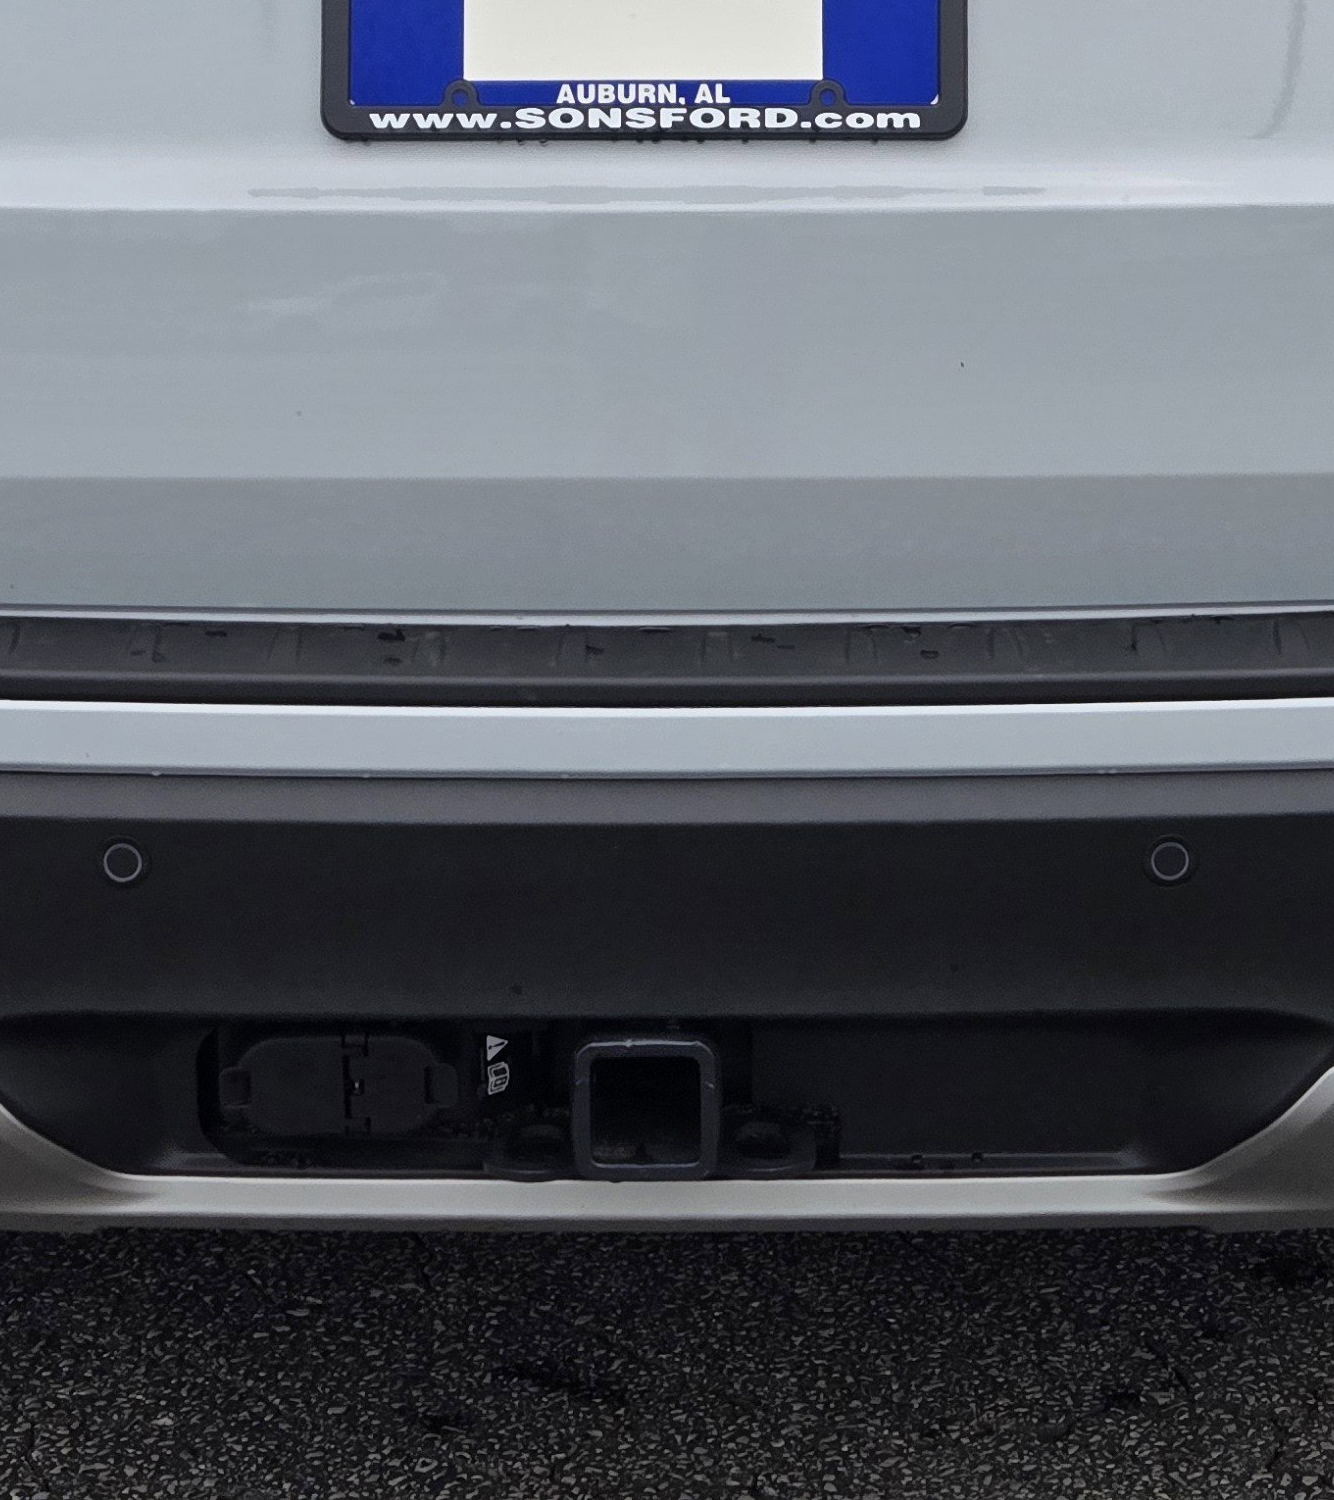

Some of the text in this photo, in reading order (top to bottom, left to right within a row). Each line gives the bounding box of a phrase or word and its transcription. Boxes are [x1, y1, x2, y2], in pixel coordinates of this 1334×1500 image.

[556, 83, 730, 105] AUBURN, AL
[369, 107, 921, 130] www.SONSFORD.com
